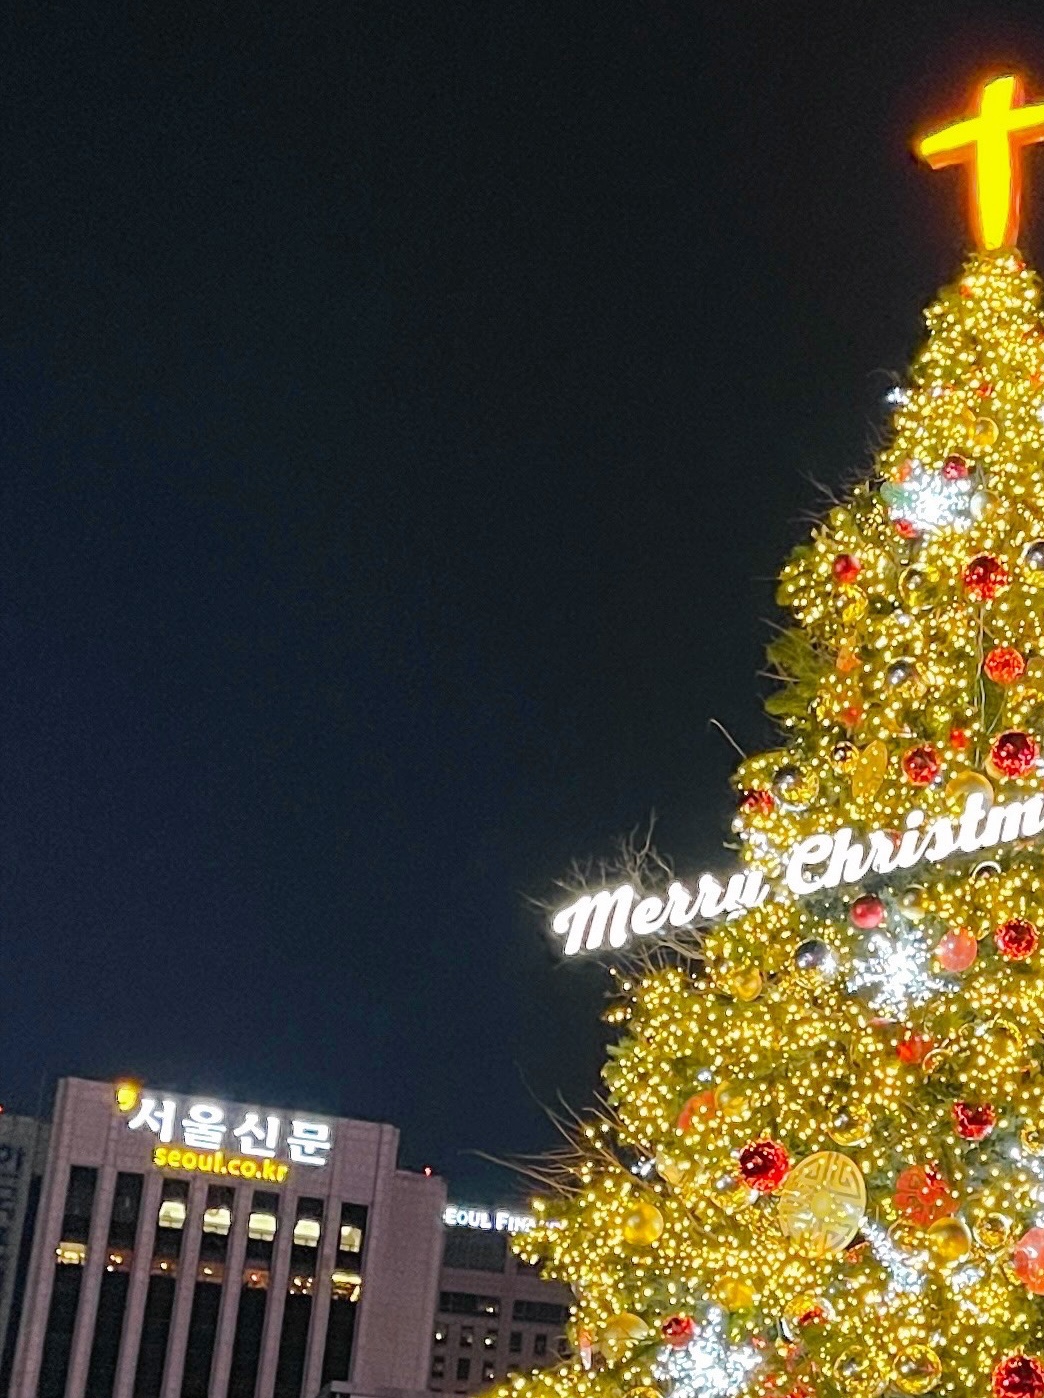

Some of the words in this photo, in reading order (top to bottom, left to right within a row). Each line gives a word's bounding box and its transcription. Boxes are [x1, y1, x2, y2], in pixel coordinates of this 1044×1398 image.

[553, 868, 771, 956] Merry
[127, 1097, 333, 1167] 서울신문
[152, 1146, 291, 1184] seoul.co.kr
[443, 1206, 493, 1231] EOUL
